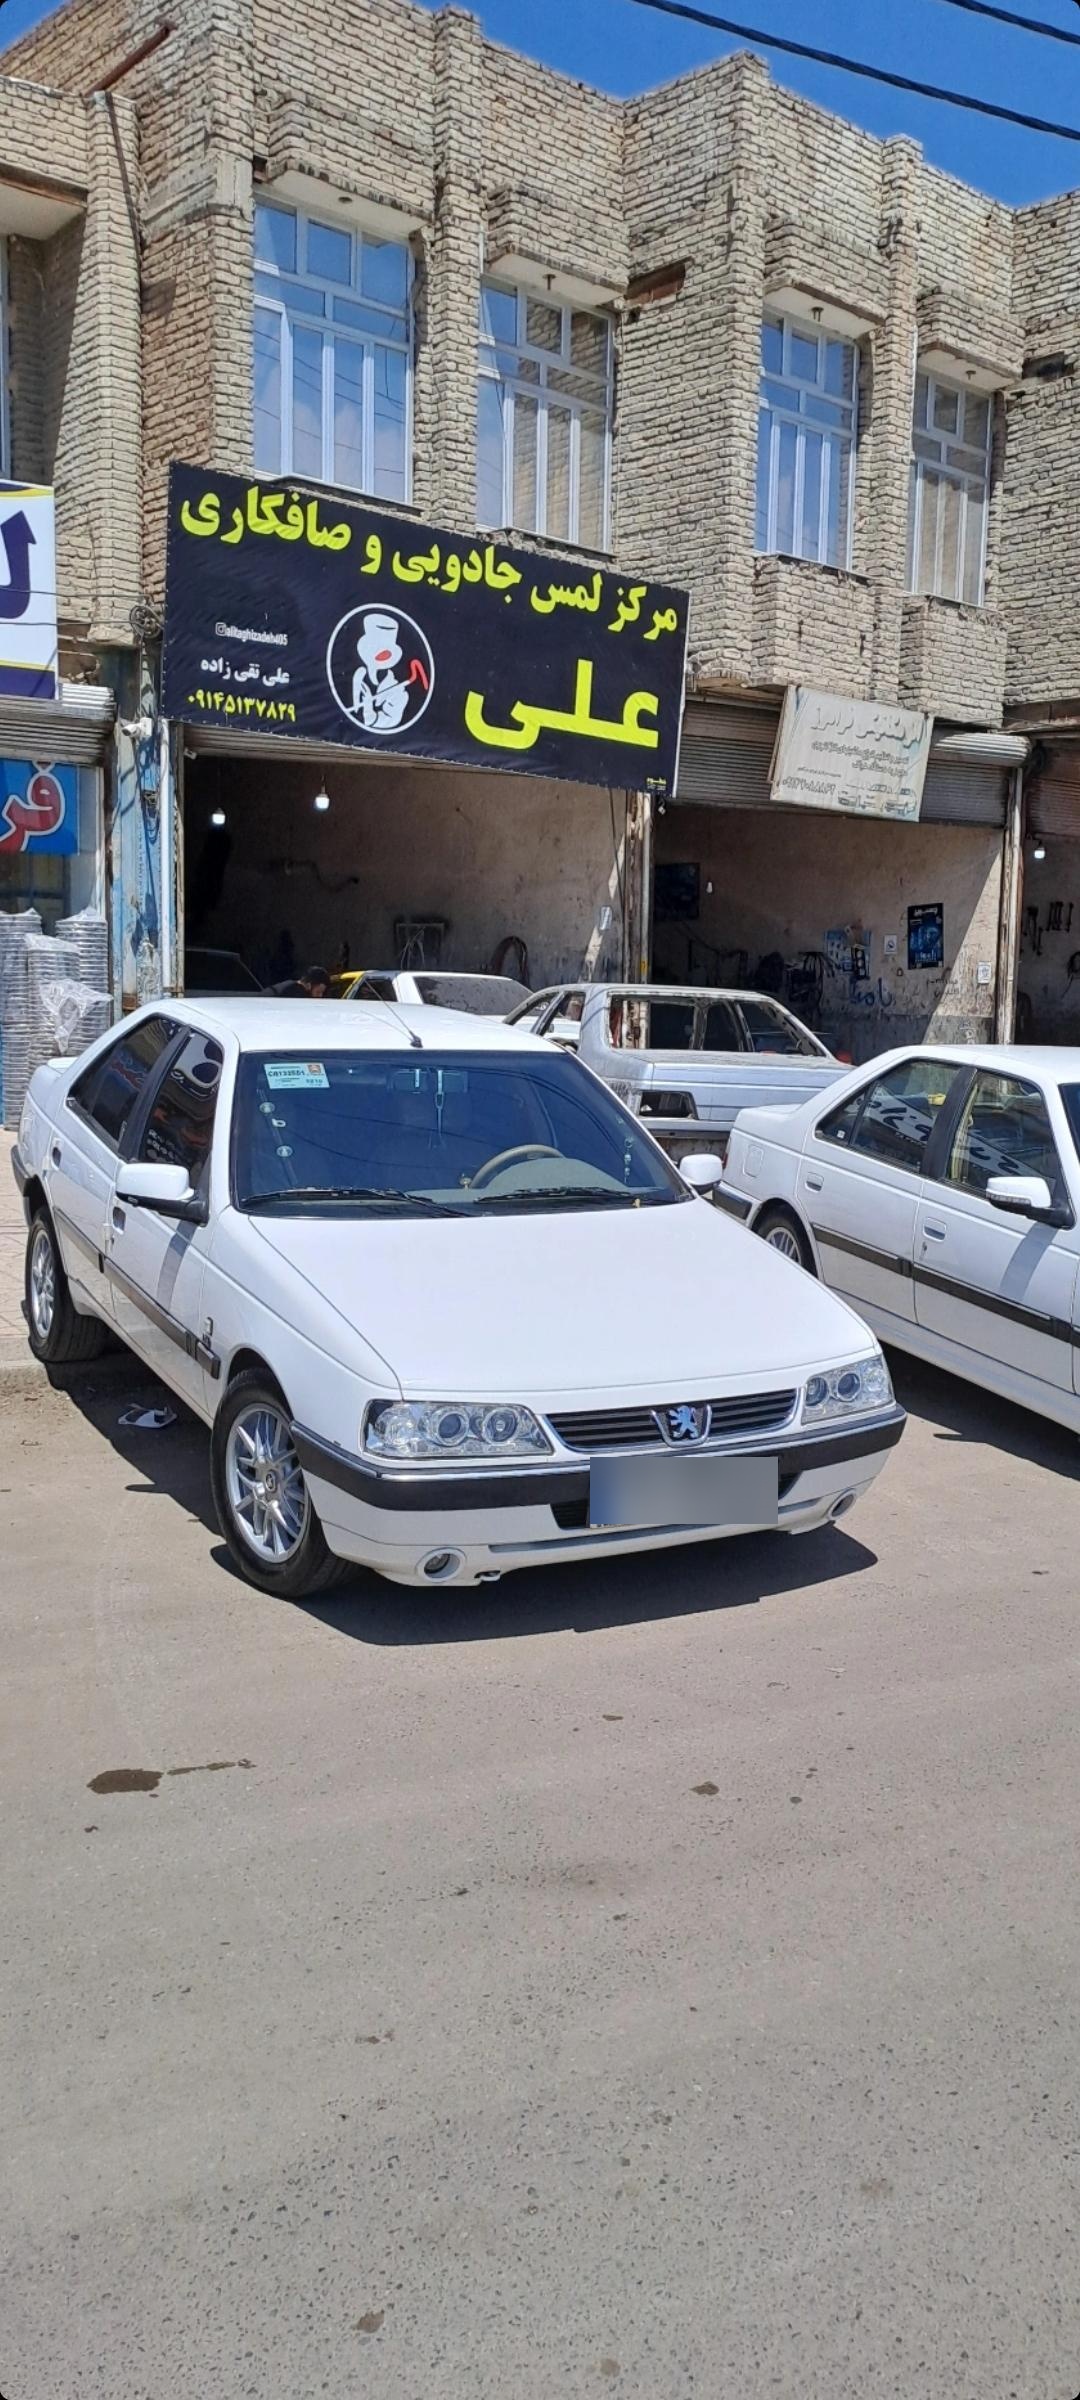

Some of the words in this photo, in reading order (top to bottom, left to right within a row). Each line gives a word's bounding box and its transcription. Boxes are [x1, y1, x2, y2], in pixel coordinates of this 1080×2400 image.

[181, 486, 351, 550] صافکاری
[360, 534, 383, 575] و
[392, 543, 523, 604] جادویی
[530, 572, 603, 614] لمس
[608, 586, 678, 641] مرکز
[200, 657, 231, 680] زاده
[234, 663, 261, 682] تقی
[262, 667, 290, 687] علی
[188, 689, 296, 722] ۰۹۱۴۵۱۳۷۸۲۹
[465, 658, 659, 750] علی
